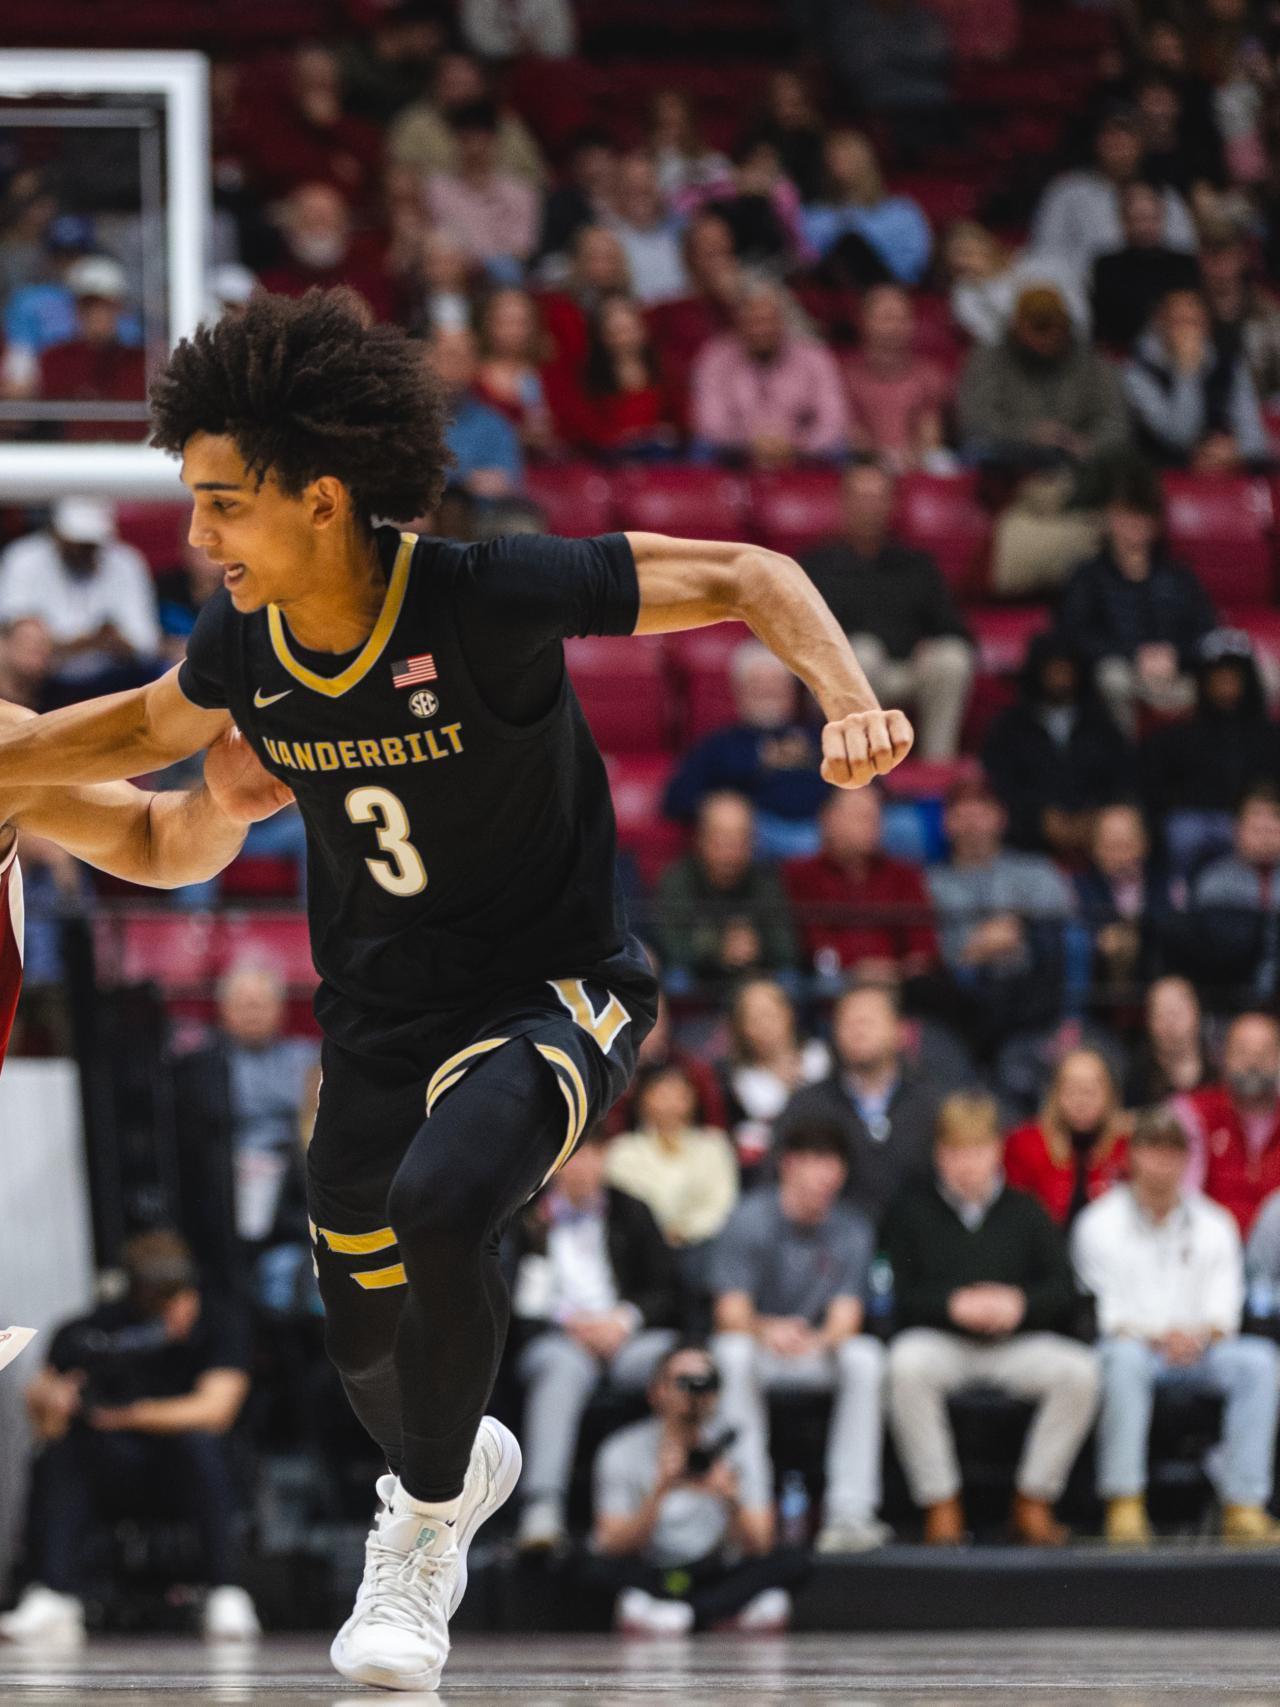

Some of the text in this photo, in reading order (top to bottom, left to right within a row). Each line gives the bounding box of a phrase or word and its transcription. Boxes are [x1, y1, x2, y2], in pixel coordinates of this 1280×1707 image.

[410, 691, 437, 716] SEC
[262, 722, 464, 772] VANDERBILT
[345, 785, 428, 897] 3
